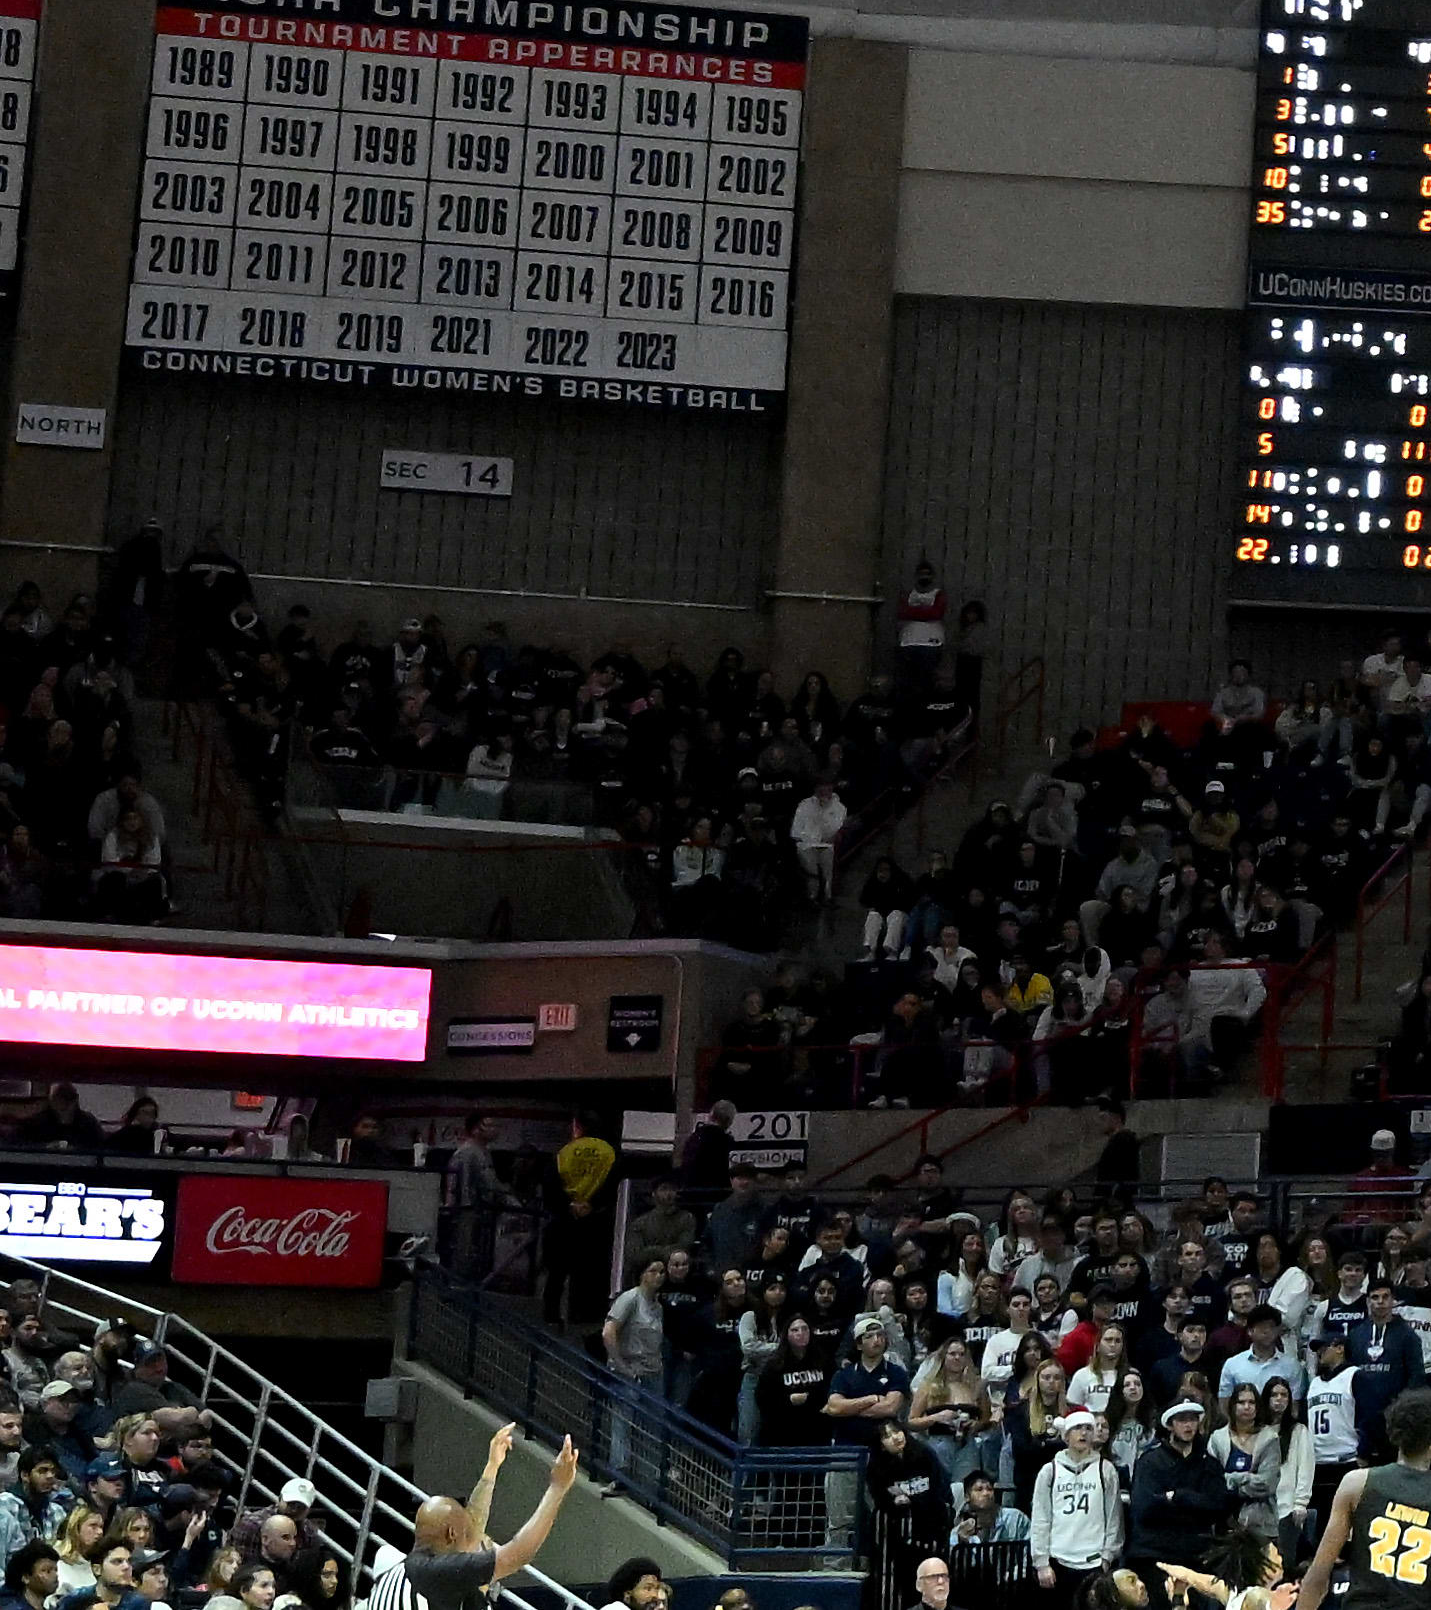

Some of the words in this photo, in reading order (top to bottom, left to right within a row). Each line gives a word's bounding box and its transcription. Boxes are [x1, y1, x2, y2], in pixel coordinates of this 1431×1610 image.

[194, 12, 466, 56] TOURNAMENT
[488, 39, 774, 83] APPEARANCES
[169, 46, 234, 88] 1989
[727, 95, 788, 136] 1995
[152, 172, 226, 213] 2003
[531, 201, 599, 242] 2007
[714, 217, 782, 257] 2009
[142, 301, 210, 342] 2017
[524, 327, 589, 367] 2022
[617, 331, 677, 371] 2023
[142, 350, 376, 384] CONNECTICUT
[392, 367, 543, 395] WOMEN'S
[560, 379, 765, 412] BASKETBALL
[20, 415, 102, 436] NORTH
[385, 460, 428, 480] SEC
[461, 462, 500, 488] 14
[28, 990, 144, 1015] PARTNER
[151, 997, 188, 1017] OF
[193, 998, 283, 1022] UCONN
[288, 1005, 419, 1030] ATHLETICS
[449, 1031, 533, 1043] CONCESSIONS
[748, 1114, 807, 1140] 201
[206, 1205, 362, 1258] Coca-Cola
[1328, 1310, 1366, 1321] UCONN
[783, 1370, 824, 1386] UCONN
[1314, 1410, 1331, 1435] 15
[1056, 1481, 1097, 1494] UCONN
[1062, 1494, 1090, 1516] 34
